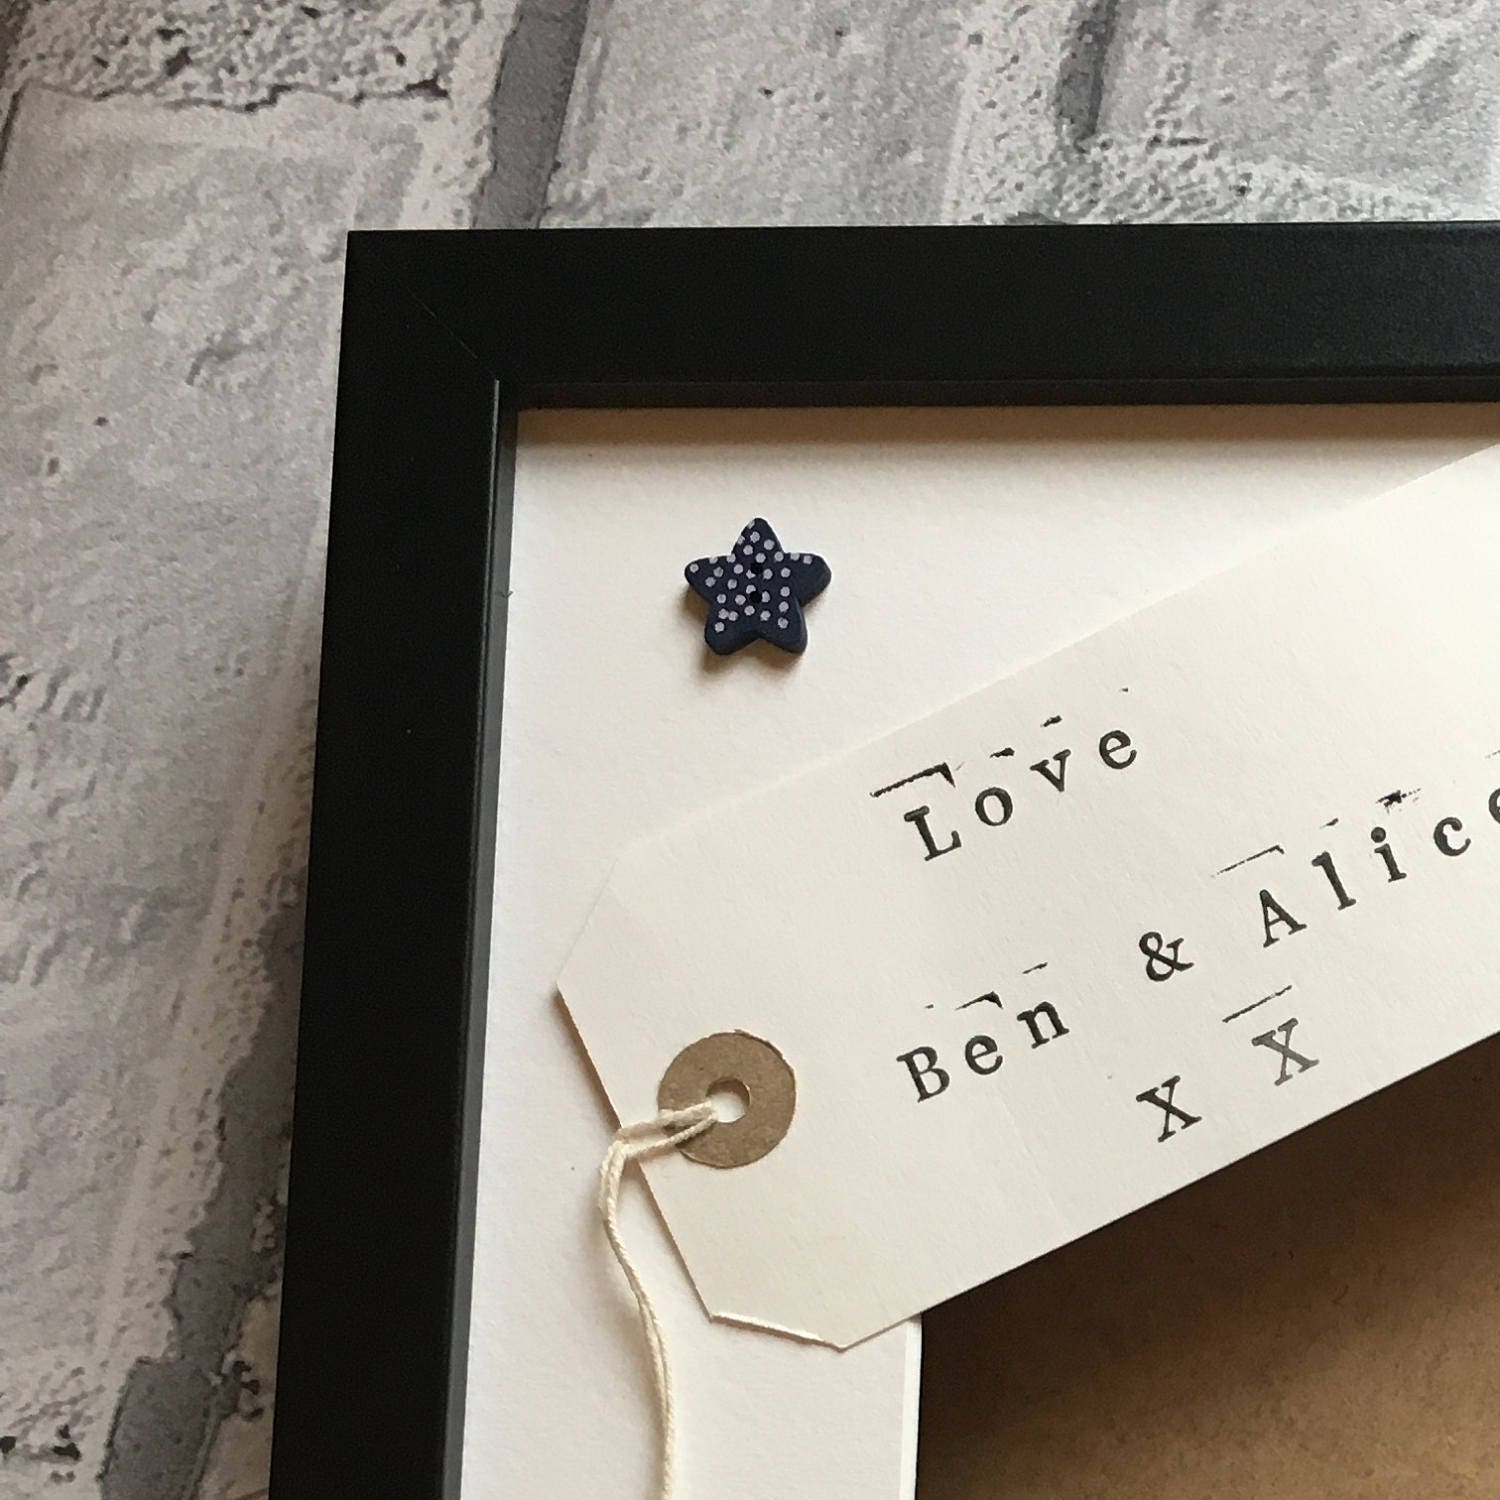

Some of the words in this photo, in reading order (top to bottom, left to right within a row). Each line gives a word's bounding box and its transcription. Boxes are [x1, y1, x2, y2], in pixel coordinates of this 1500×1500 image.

[903, 727, 1138, 862] Love
[896, 1000, 1071, 1104] Ben
[1137, 931, 1195, 983] &
